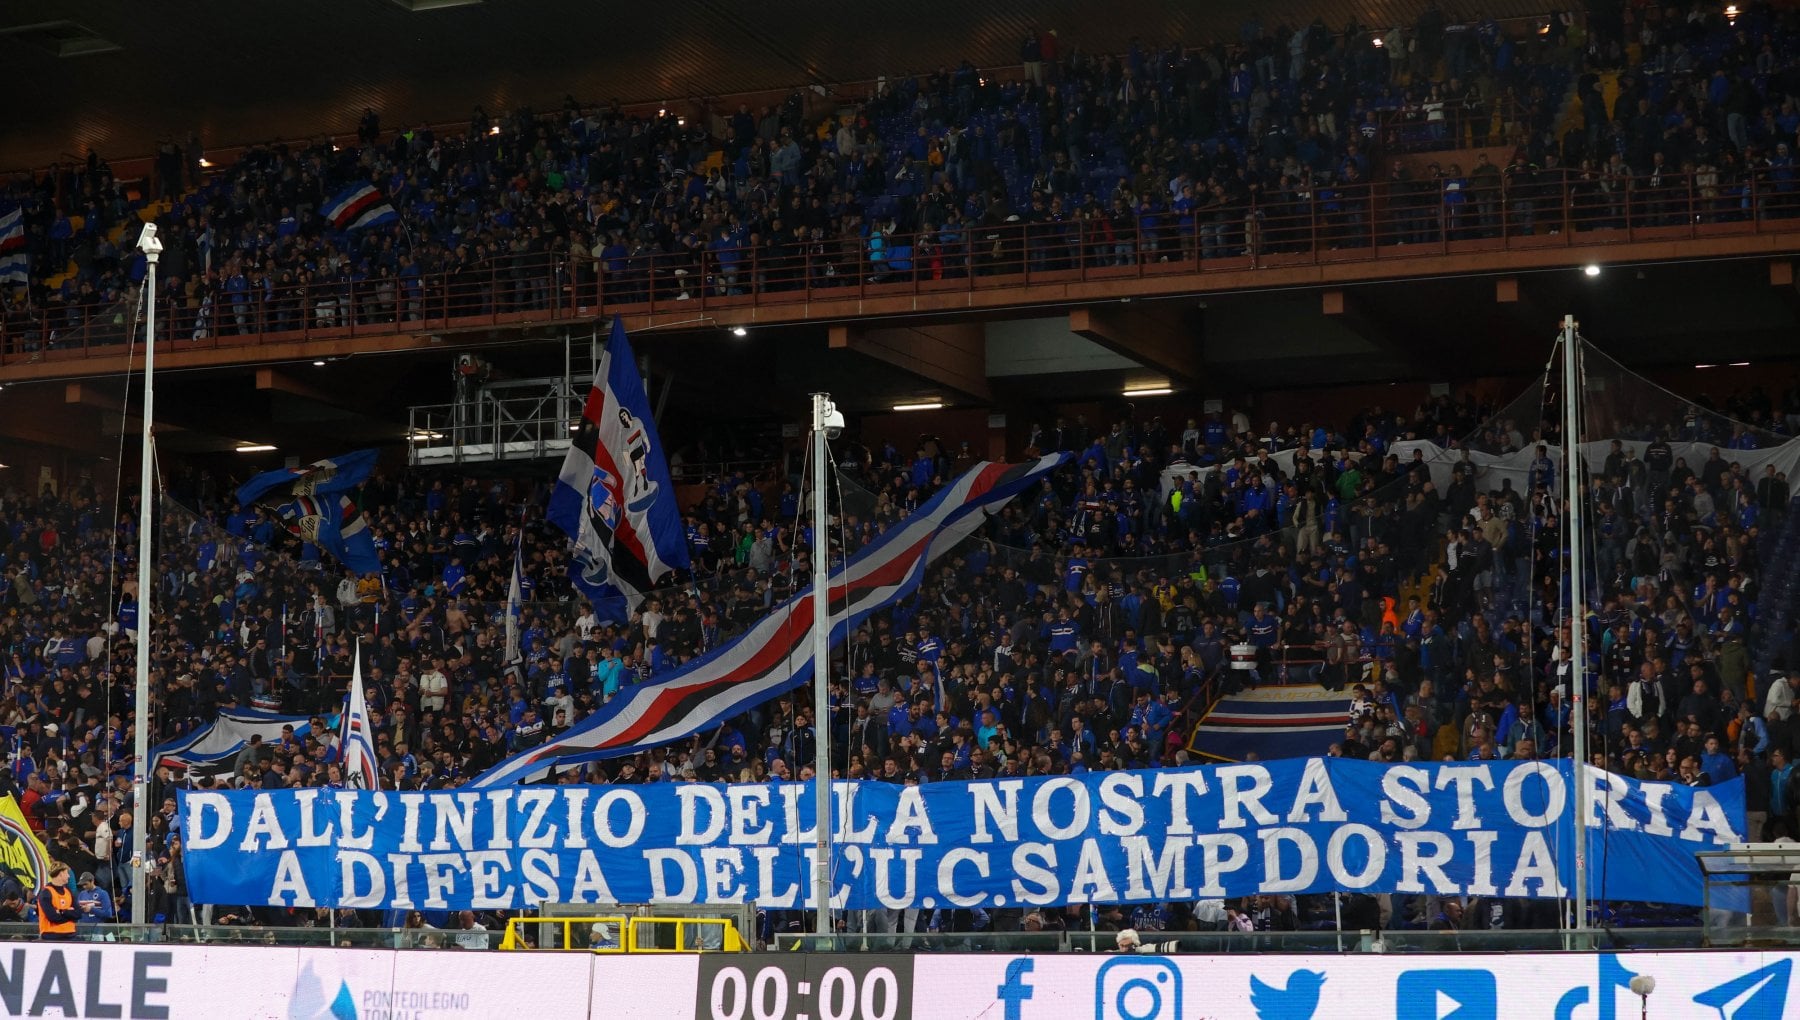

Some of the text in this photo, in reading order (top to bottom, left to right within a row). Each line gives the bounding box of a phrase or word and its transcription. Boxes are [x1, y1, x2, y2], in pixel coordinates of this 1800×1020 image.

[185, 758, 1743, 852] DALL'INIZIO DELLA NOSTRA STORIA
[267, 850, 316, 907] A
[336, 848, 618, 909] DIFESA
[710, 966, 898, 1020] 00:00
